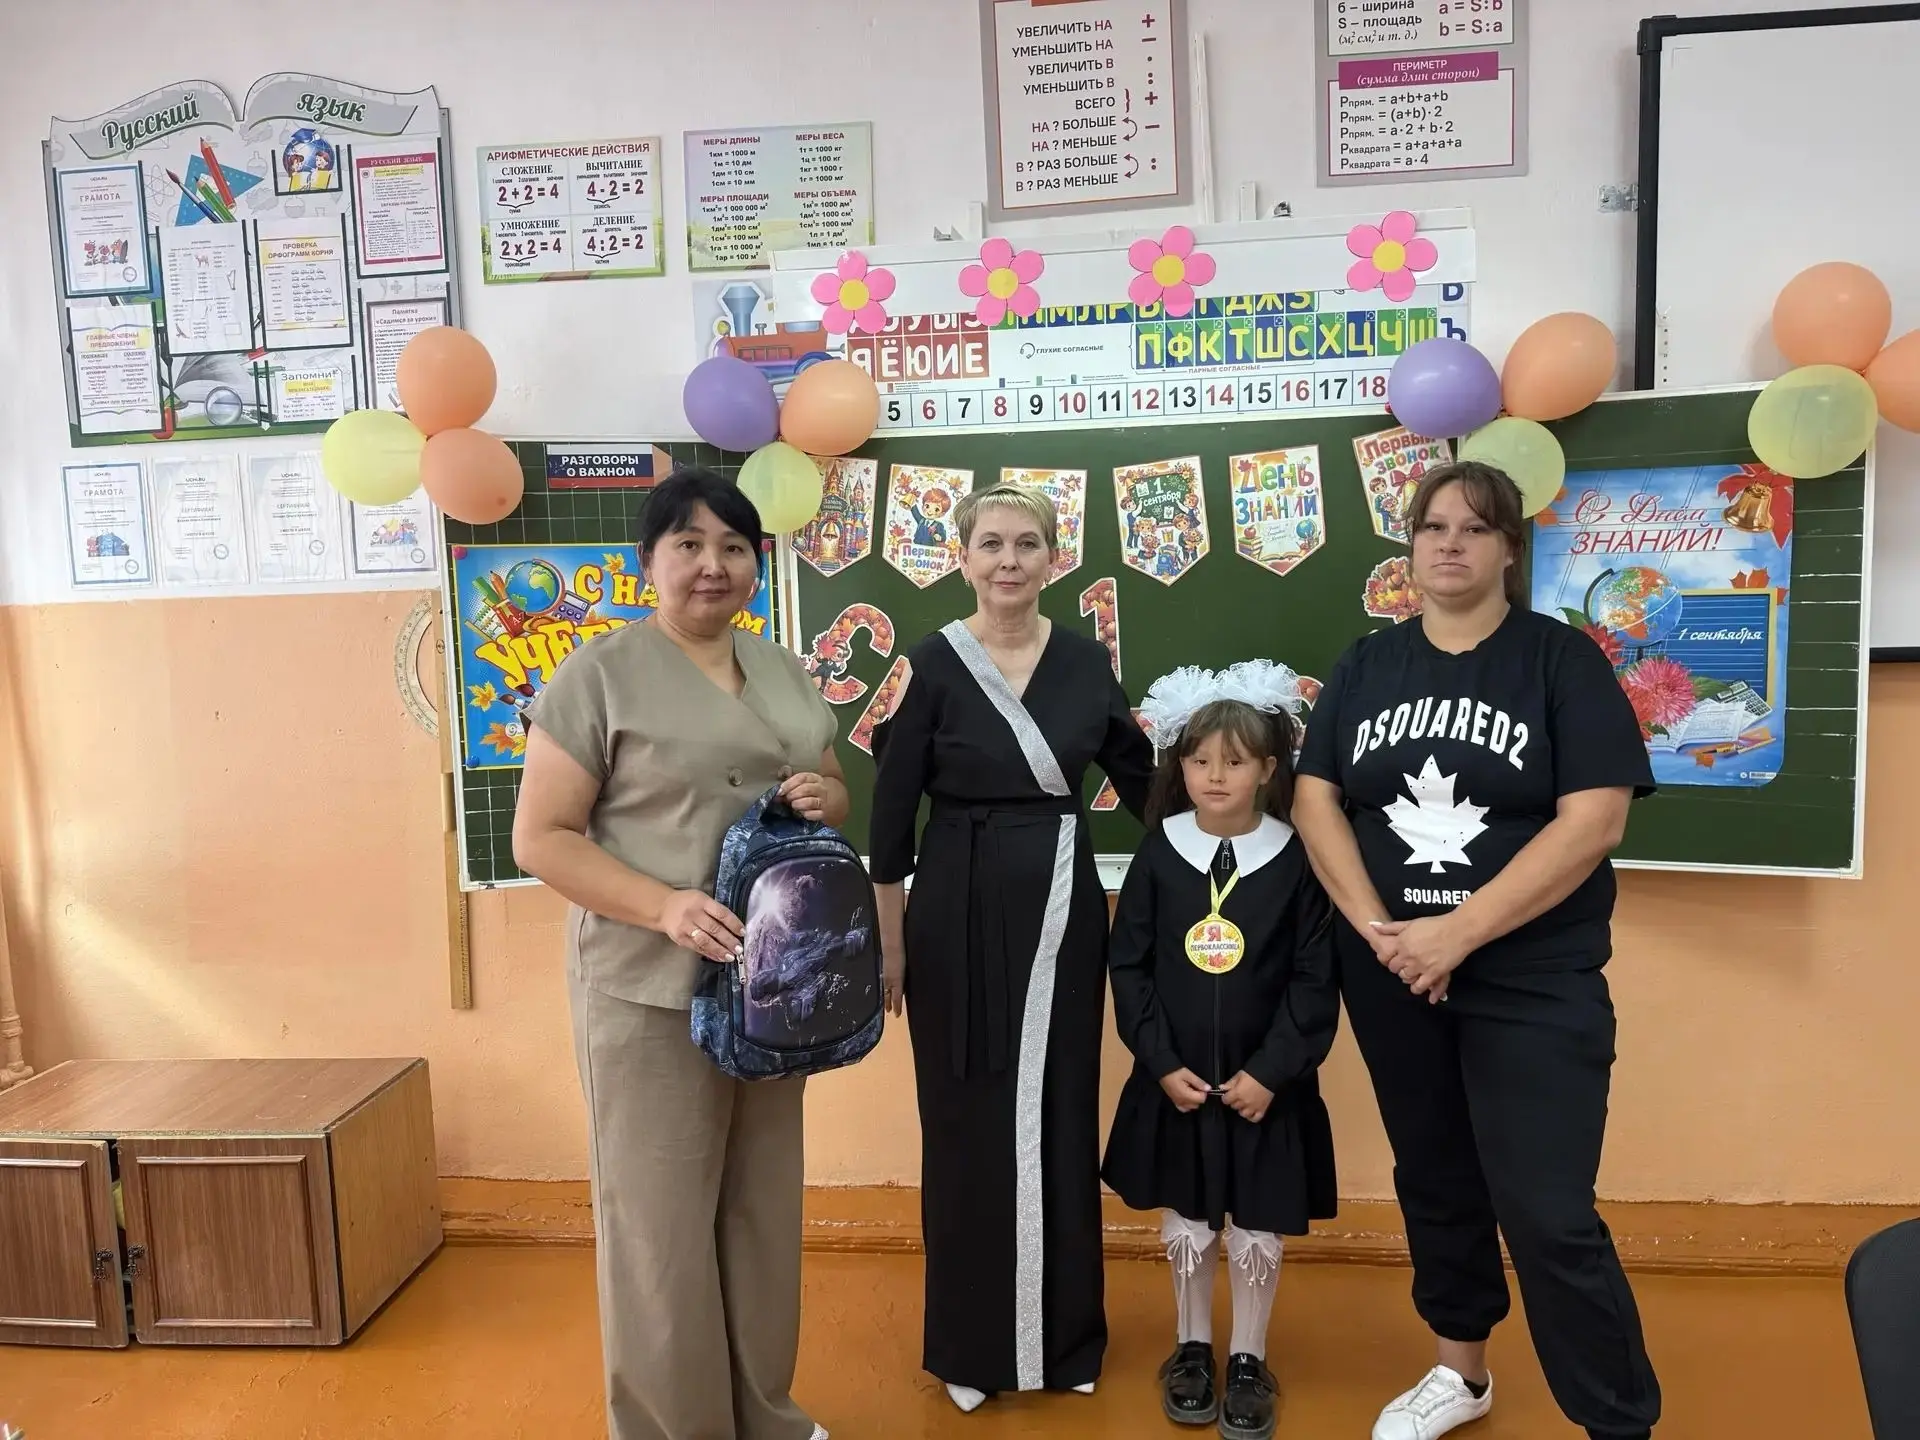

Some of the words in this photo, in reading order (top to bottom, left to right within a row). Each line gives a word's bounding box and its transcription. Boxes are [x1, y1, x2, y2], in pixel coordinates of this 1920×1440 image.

[1362, 0, 1415, 13] ширина
[1016, 22, 1092, 38] УВЕЛИЧИТЬ
[1094, 19, 1113, 31] НА
[1338, 17, 1347, 29] S
[1363, 15, 1422, 28] площадь
[1012, 41, 1092, 58] УМЕНЬШИТЬ
[1095, 39, 1114, 51] НА
[1027, 60, 1103, 76] УВЕЛИЧИТЬ
[1105, 58, 1114, 69] В
[1393, 60, 1448, 71] ПЕРИМЕТР
[1357, 73, 1398, 87] (сумма
[1401, 72, 1429, 82] длин
[1431, 67, 1480, 81] сторон)
[1023, 79, 1104, 95] УМЕНЬШИТЬ
[1106, 77, 1115, 88] В
[1075, 96, 1116, 110] ВСЕГО
[103, 93, 200, 149] Русский
[297, 93, 366, 122] язык
[1032, 122, 1050, 133] НА
[1062, 116, 1117, 131] БОЛЬШЕ
[703, 138, 727, 146] МЕРЫ
[729, 136, 761, 145] ДЛИНЫ
[795, 133, 821, 141] МЕРЫ
[822, 132, 845, 140] ВЕСА
[1031, 141, 1050, 152] НА
[1062, 135, 1117, 150] МЕНЬШЕ
[487, 147, 590, 161] АРИФМЕТИЧЕСКИЕ
[592, 143, 650, 157] ДЕЙСТВИЯ
[586, 160, 643, 171] ВЫЧИТАНИЕ
[1016, 162, 1024, 172] В
[1037, 159, 1061, 171] РАЗ
[1064, 153, 1118, 169] БОЛЬШЕ
[501, 165, 554, 176] СЛОЖЕНИЕ
[1016, 181, 1024, 192] В
[1037, 178, 1061, 190] РАЗ
[1063, 172, 1119, 189] МЕНЬШЕ
[79, 192, 121, 202] ГРАМОТА
[727, 193, 769, 202] ПЛОЩАДИ
[794, 191, 819, 199] МЕРЫ
[820, 189, 857, 198] ОБЪЕМА
[501, 219, 560, 230] УМНОЖЕНИЕ
[593, 215, 635, 227] ДЕЛЕНИЕ
[282, 242, 317, 250] ПРОВЕРКА
[267, 250, 310, 259] ОРФОГРАММ
[311, 249, 334, 257] КОРНЯ
[86, 333, 116, 341] ГЛАВНЫЕ
[1063, 345, 1104, 353] СОГЛАСНЫЕ
[1188, 366, 1218, 374] ПАРНЫЕ
[1219, 364, 1261, 373] СОГЛАСНЫЕ
[887, 400, 901, 421] 5
[922, 398, 936, 420] 6
[958, 397, 972, 418] 7
[994, 395, 1008, 417] 8
[1029, 394, 1043, 416] 9
[1059, 391, 1087, 414] 10
[1098, 390, 1121, 412] 11
[1131, 388, 1160, 410] 12
[1168, 386, 1197, 408] 13
[1206, 384, 1234, 406] 14
[1243, 382, 1272, 404] 15
[1281, 379, 1311, 401] 16
[1319, 377, 1348, 400] 17
[1357, 375, 1386, 398] 18
[561, 455, 639, 466] РАЗГОВОРЫ
[566, 467, 577, 477] О
[579, 466, 636, 477] ВАЖНОМ
[83, 488, 124, 497] ГРАМОТА
[1153, 477, 1164, 495] 1
[1143, 490, 1181, 507] сентября
[1235, 488, 1318, 525] ЗНАНИЙ
[1559, 489, 1612, 525] С
[1570, 521, 1725, 555] ЗНАНИЙ!
[902, 545, 946, 559] Первый
[573, 565, 604, 604] С
[1678, 627, 1687, 641] 1
[1690, 626, 1764, 643] сентября
[1352, 697, 1529, 771] DSQUARED2
[1207, 924, 1221, 941] Я
[1190, 943, 1240, 952] ПЕРВОКЛАССНИЦА
